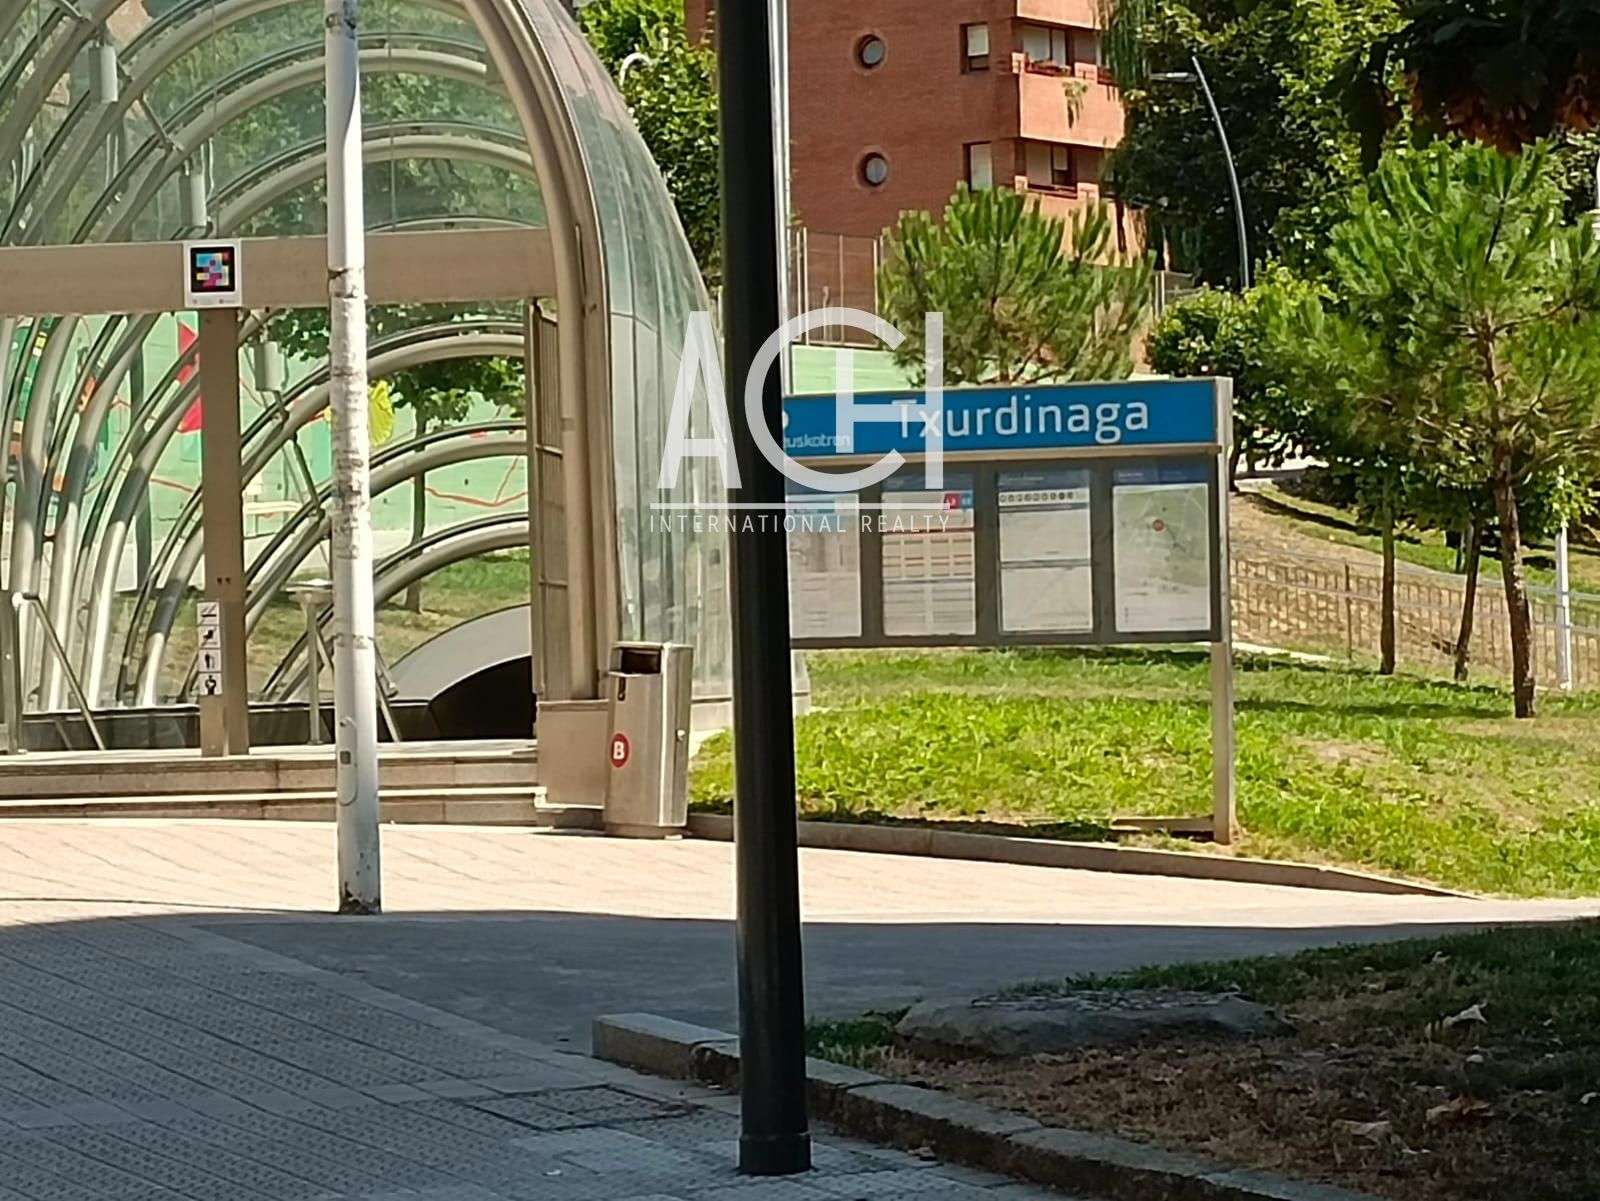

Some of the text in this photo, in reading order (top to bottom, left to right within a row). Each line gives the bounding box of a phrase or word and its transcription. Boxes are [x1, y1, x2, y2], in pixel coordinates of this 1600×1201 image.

[893, 395, 1150, 445] Txurdinaga
[782, 433, 851, 449] uskotren
[613, 742, 625, 759] B
